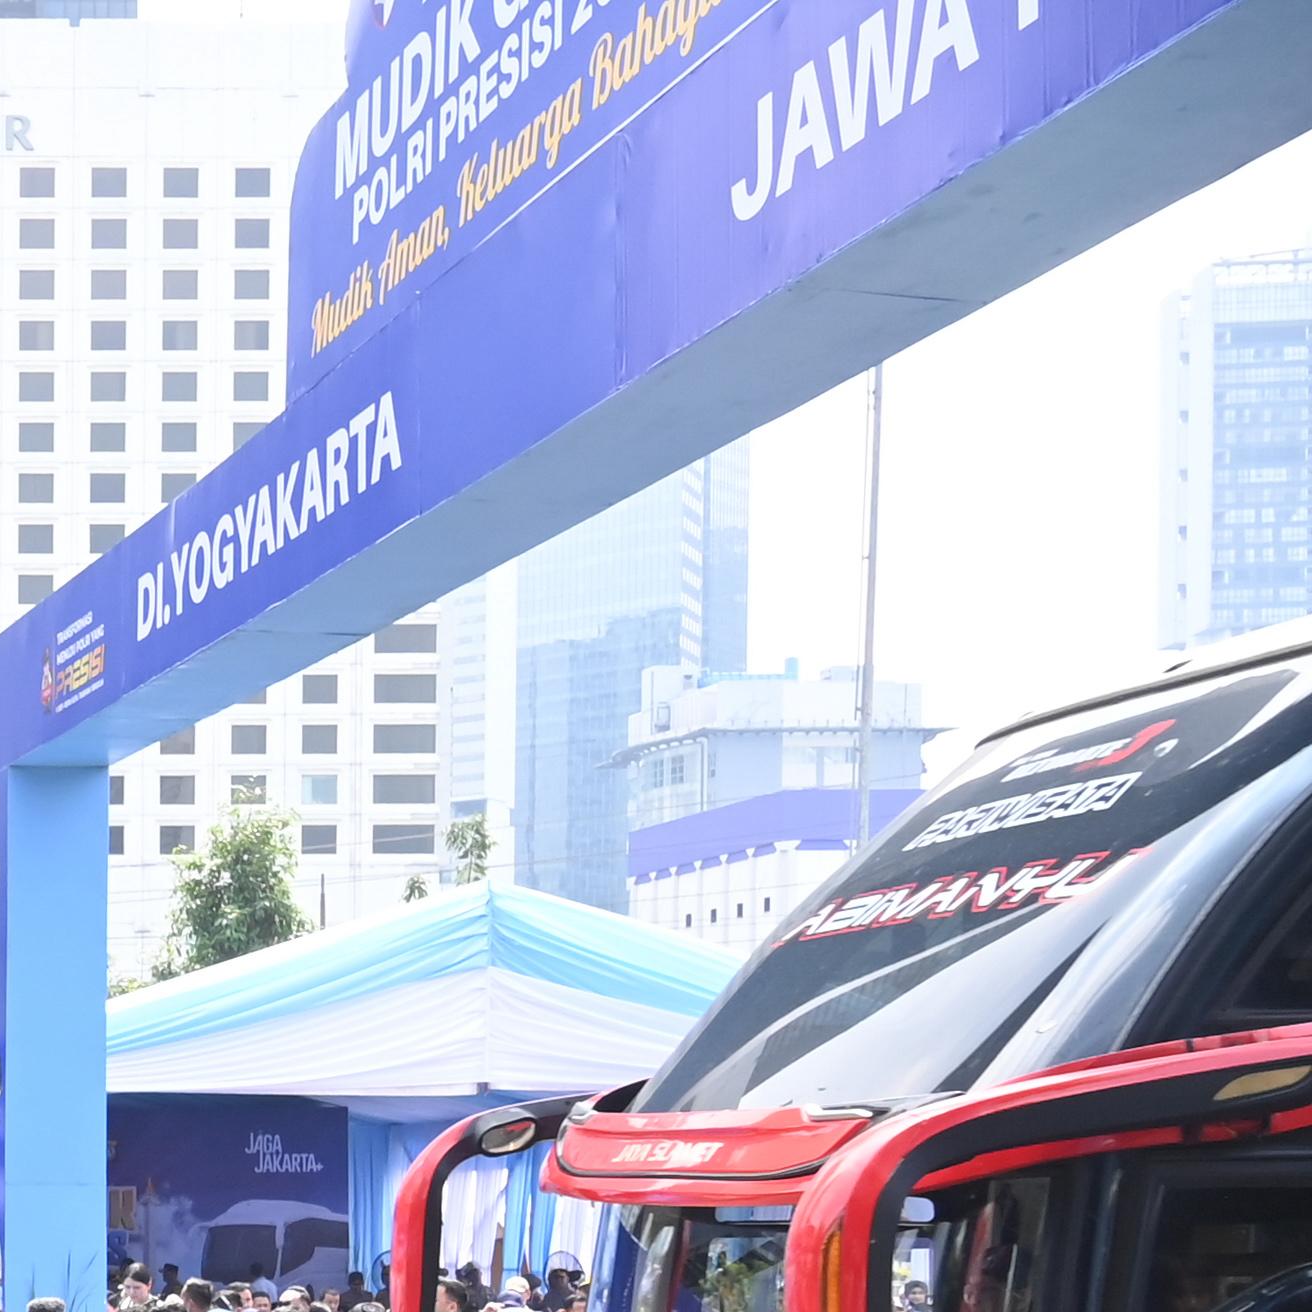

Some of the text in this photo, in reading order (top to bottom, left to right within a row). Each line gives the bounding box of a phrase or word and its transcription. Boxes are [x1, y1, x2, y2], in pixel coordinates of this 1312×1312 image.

[334, 0, 481, 200] MUDIK
[352, 0, 565, 245] POLRI PRESISI
[730, 0, 981, 221] JAWA
[310, 258, 375, 359] Mudik
[378, 203, 452, 305] Aman,
[456, 76, 584, 229] Keluarga
[773, 847, 1152, 947] ABIMANYU
[902, 771, 1143, 852] PARIWISATA
[244, 1131, 282, 1154] JAGA
